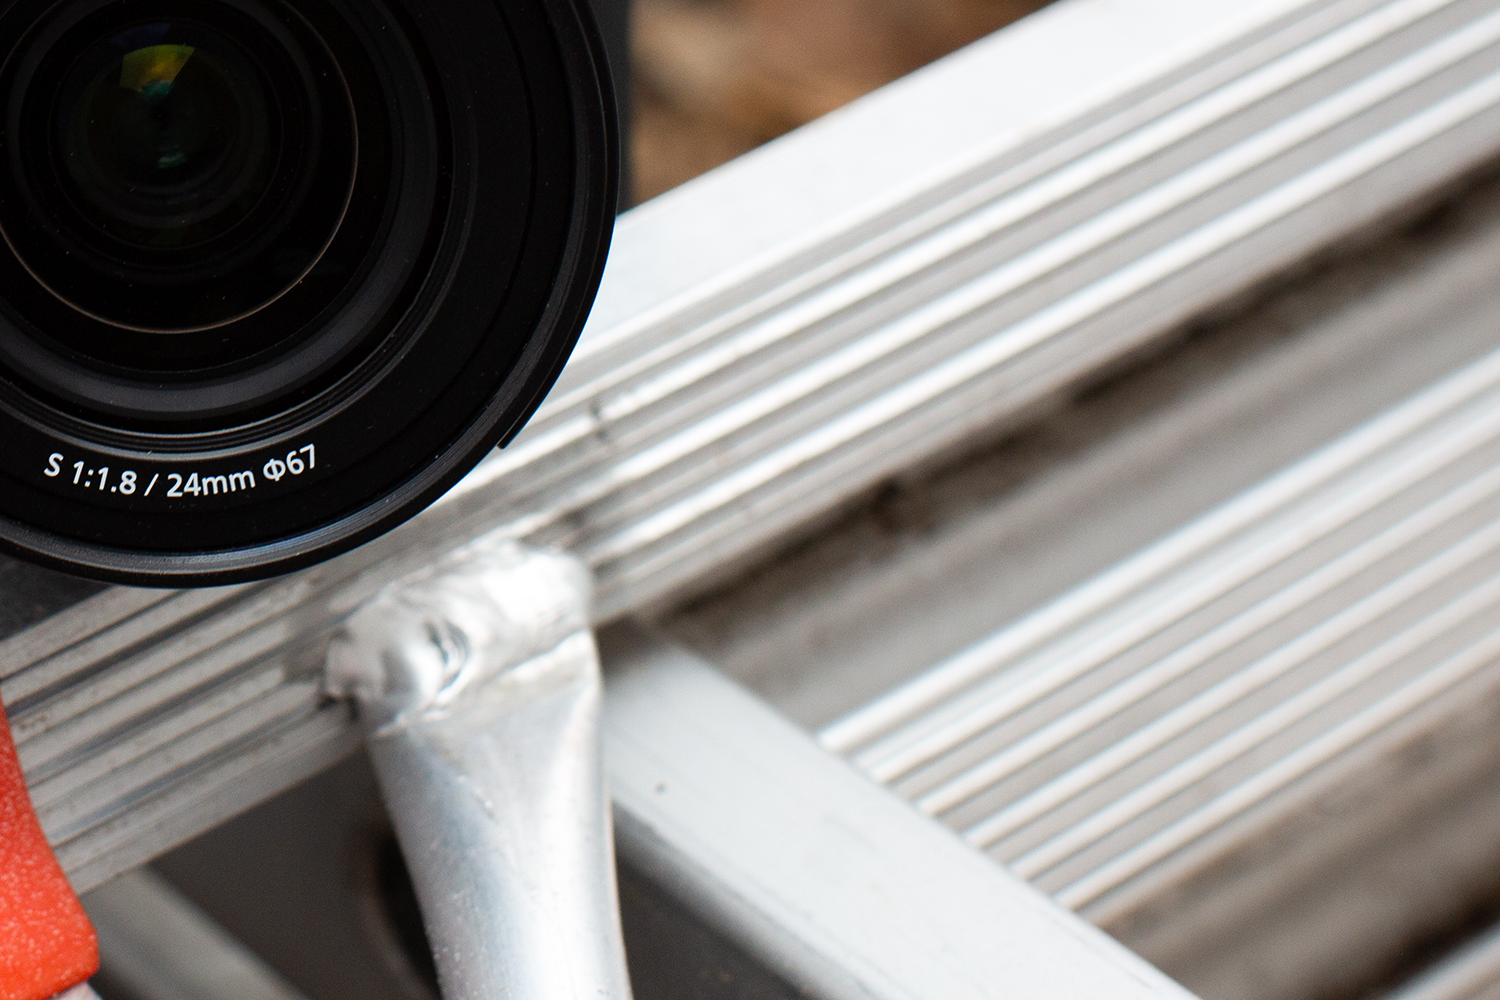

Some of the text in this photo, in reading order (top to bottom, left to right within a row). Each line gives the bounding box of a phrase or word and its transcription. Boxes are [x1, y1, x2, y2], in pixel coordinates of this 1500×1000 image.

[43, 452, 64, 477] S
[72, 460, 137, 495] 1:1.8
[143, 472, 160, 497] /
[166, 470, 257, 498] 24mm
